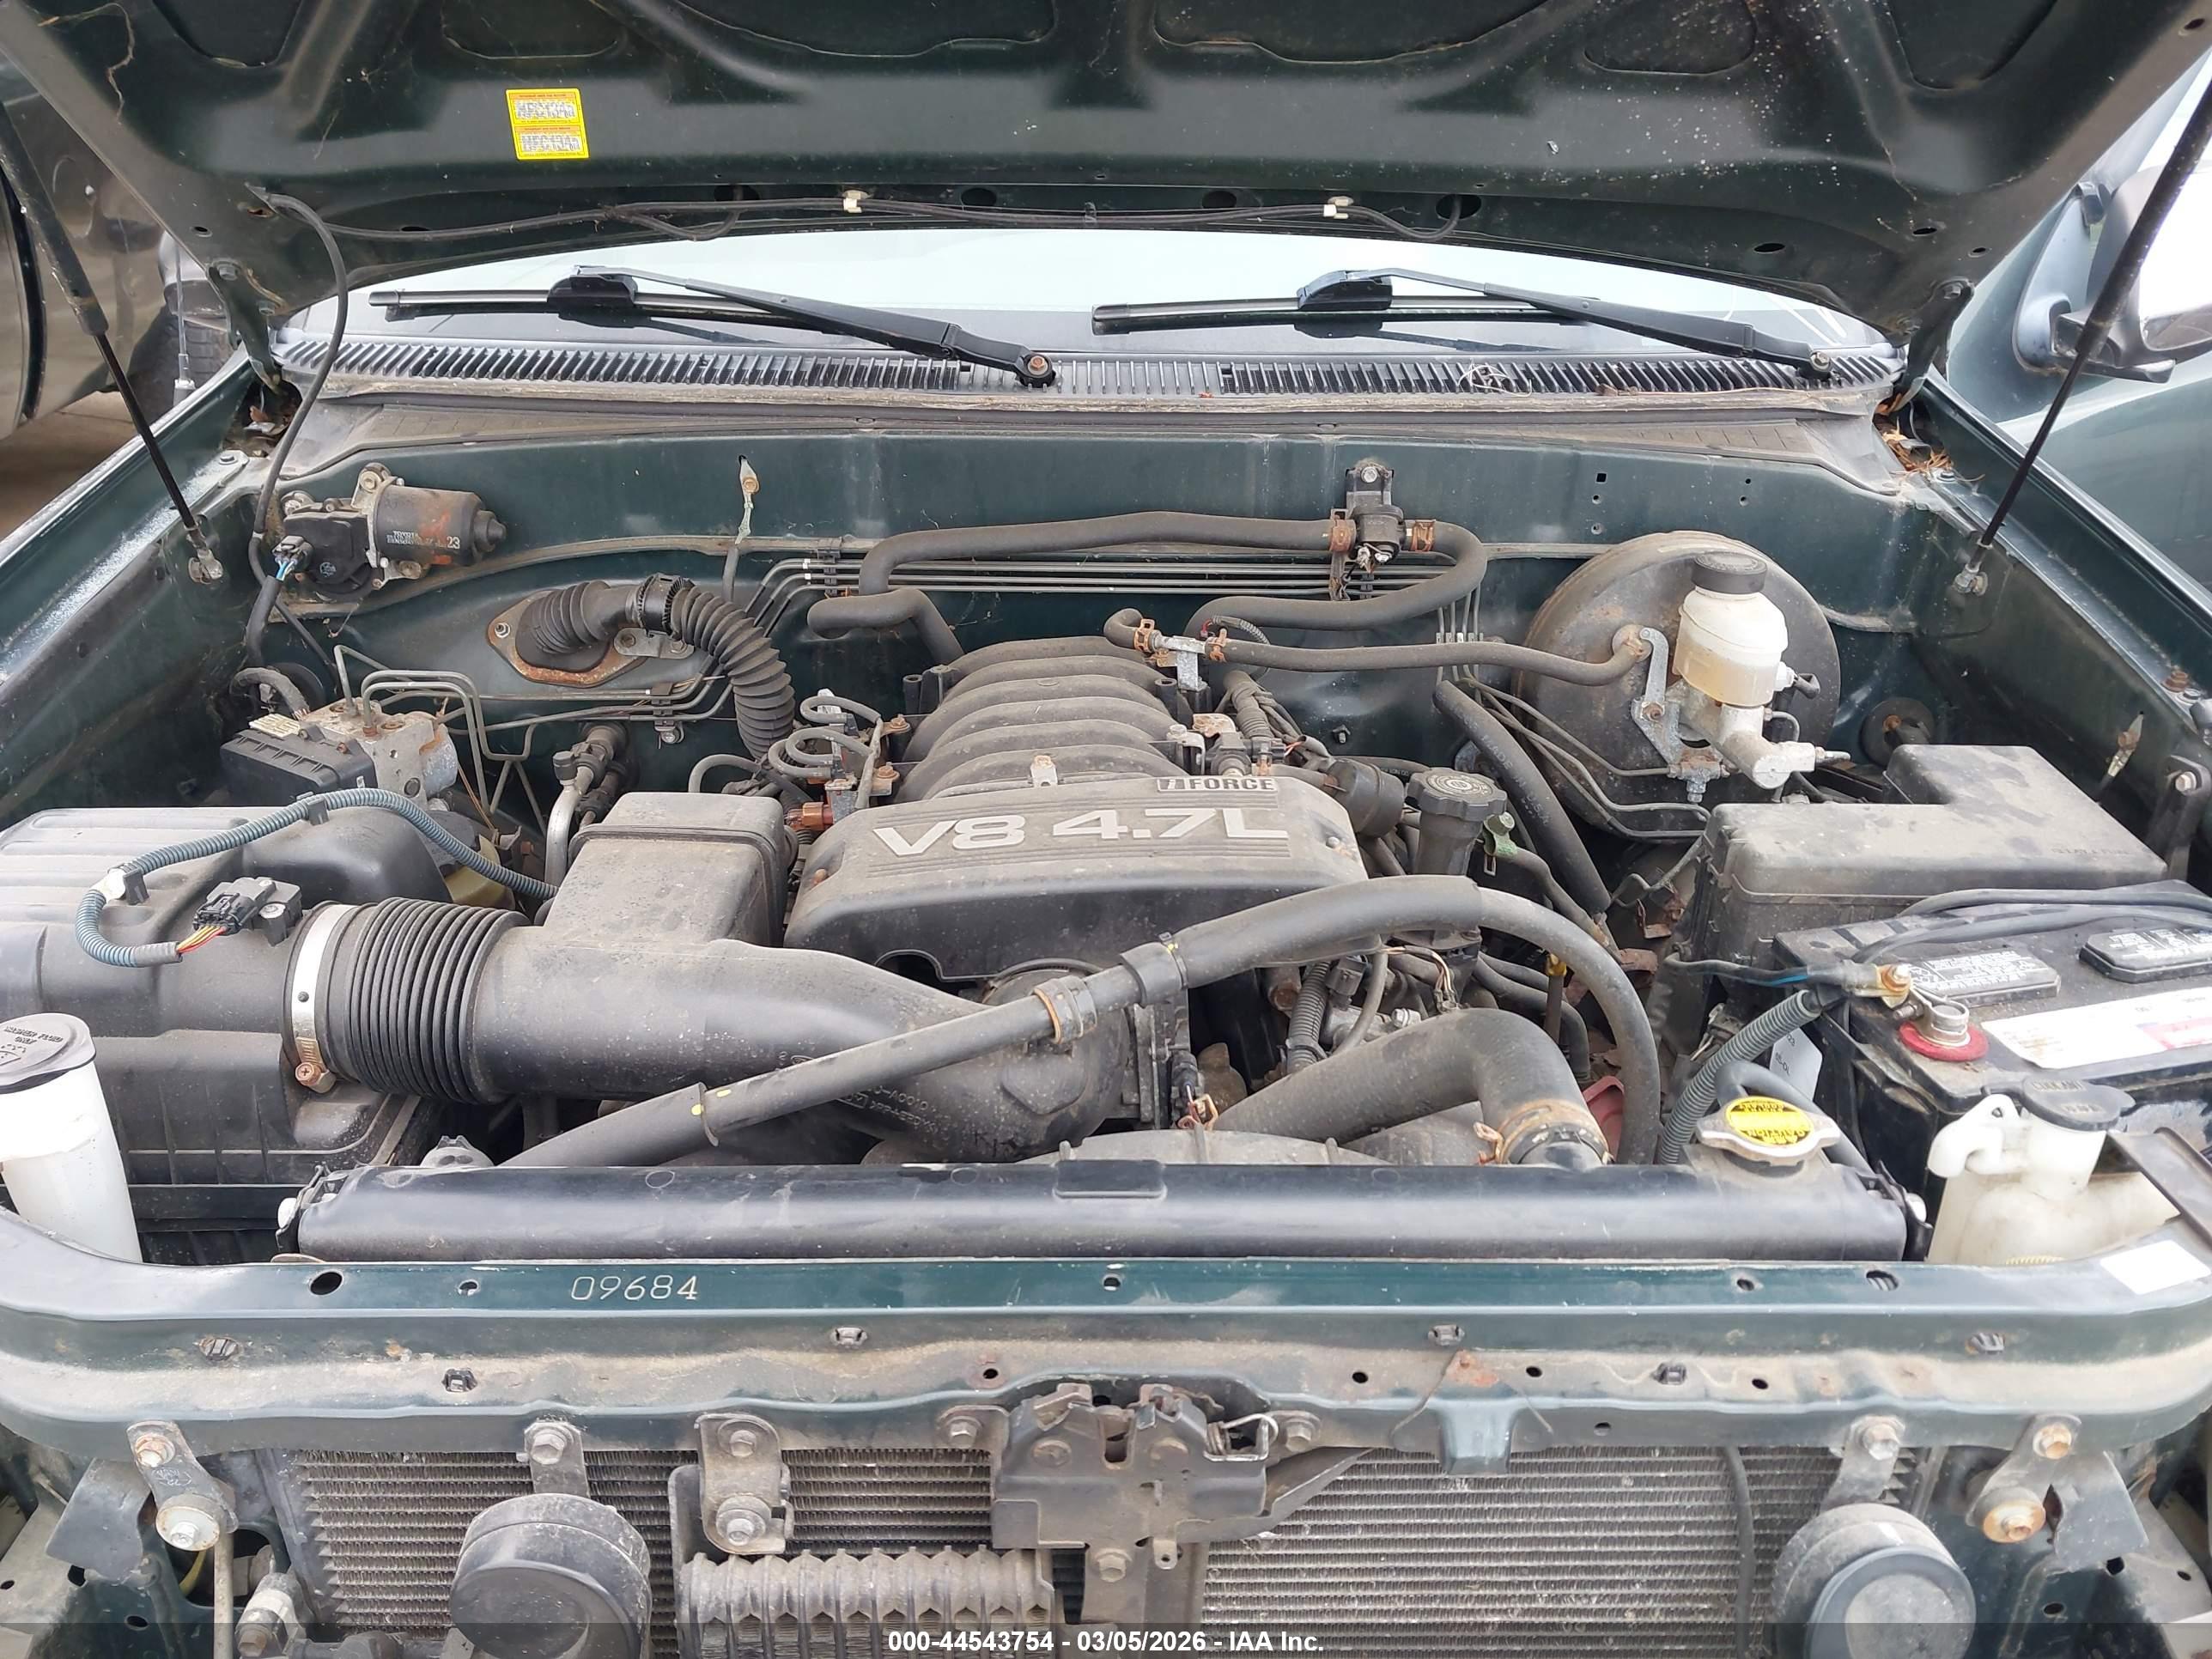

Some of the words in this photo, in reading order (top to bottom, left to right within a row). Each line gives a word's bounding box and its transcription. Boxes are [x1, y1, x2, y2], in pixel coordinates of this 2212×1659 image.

[873, 814, 1026, 857] V8
[1053, 808, 1290, 840] 4.7L
[570, 1274, 698, 1301] 09684
